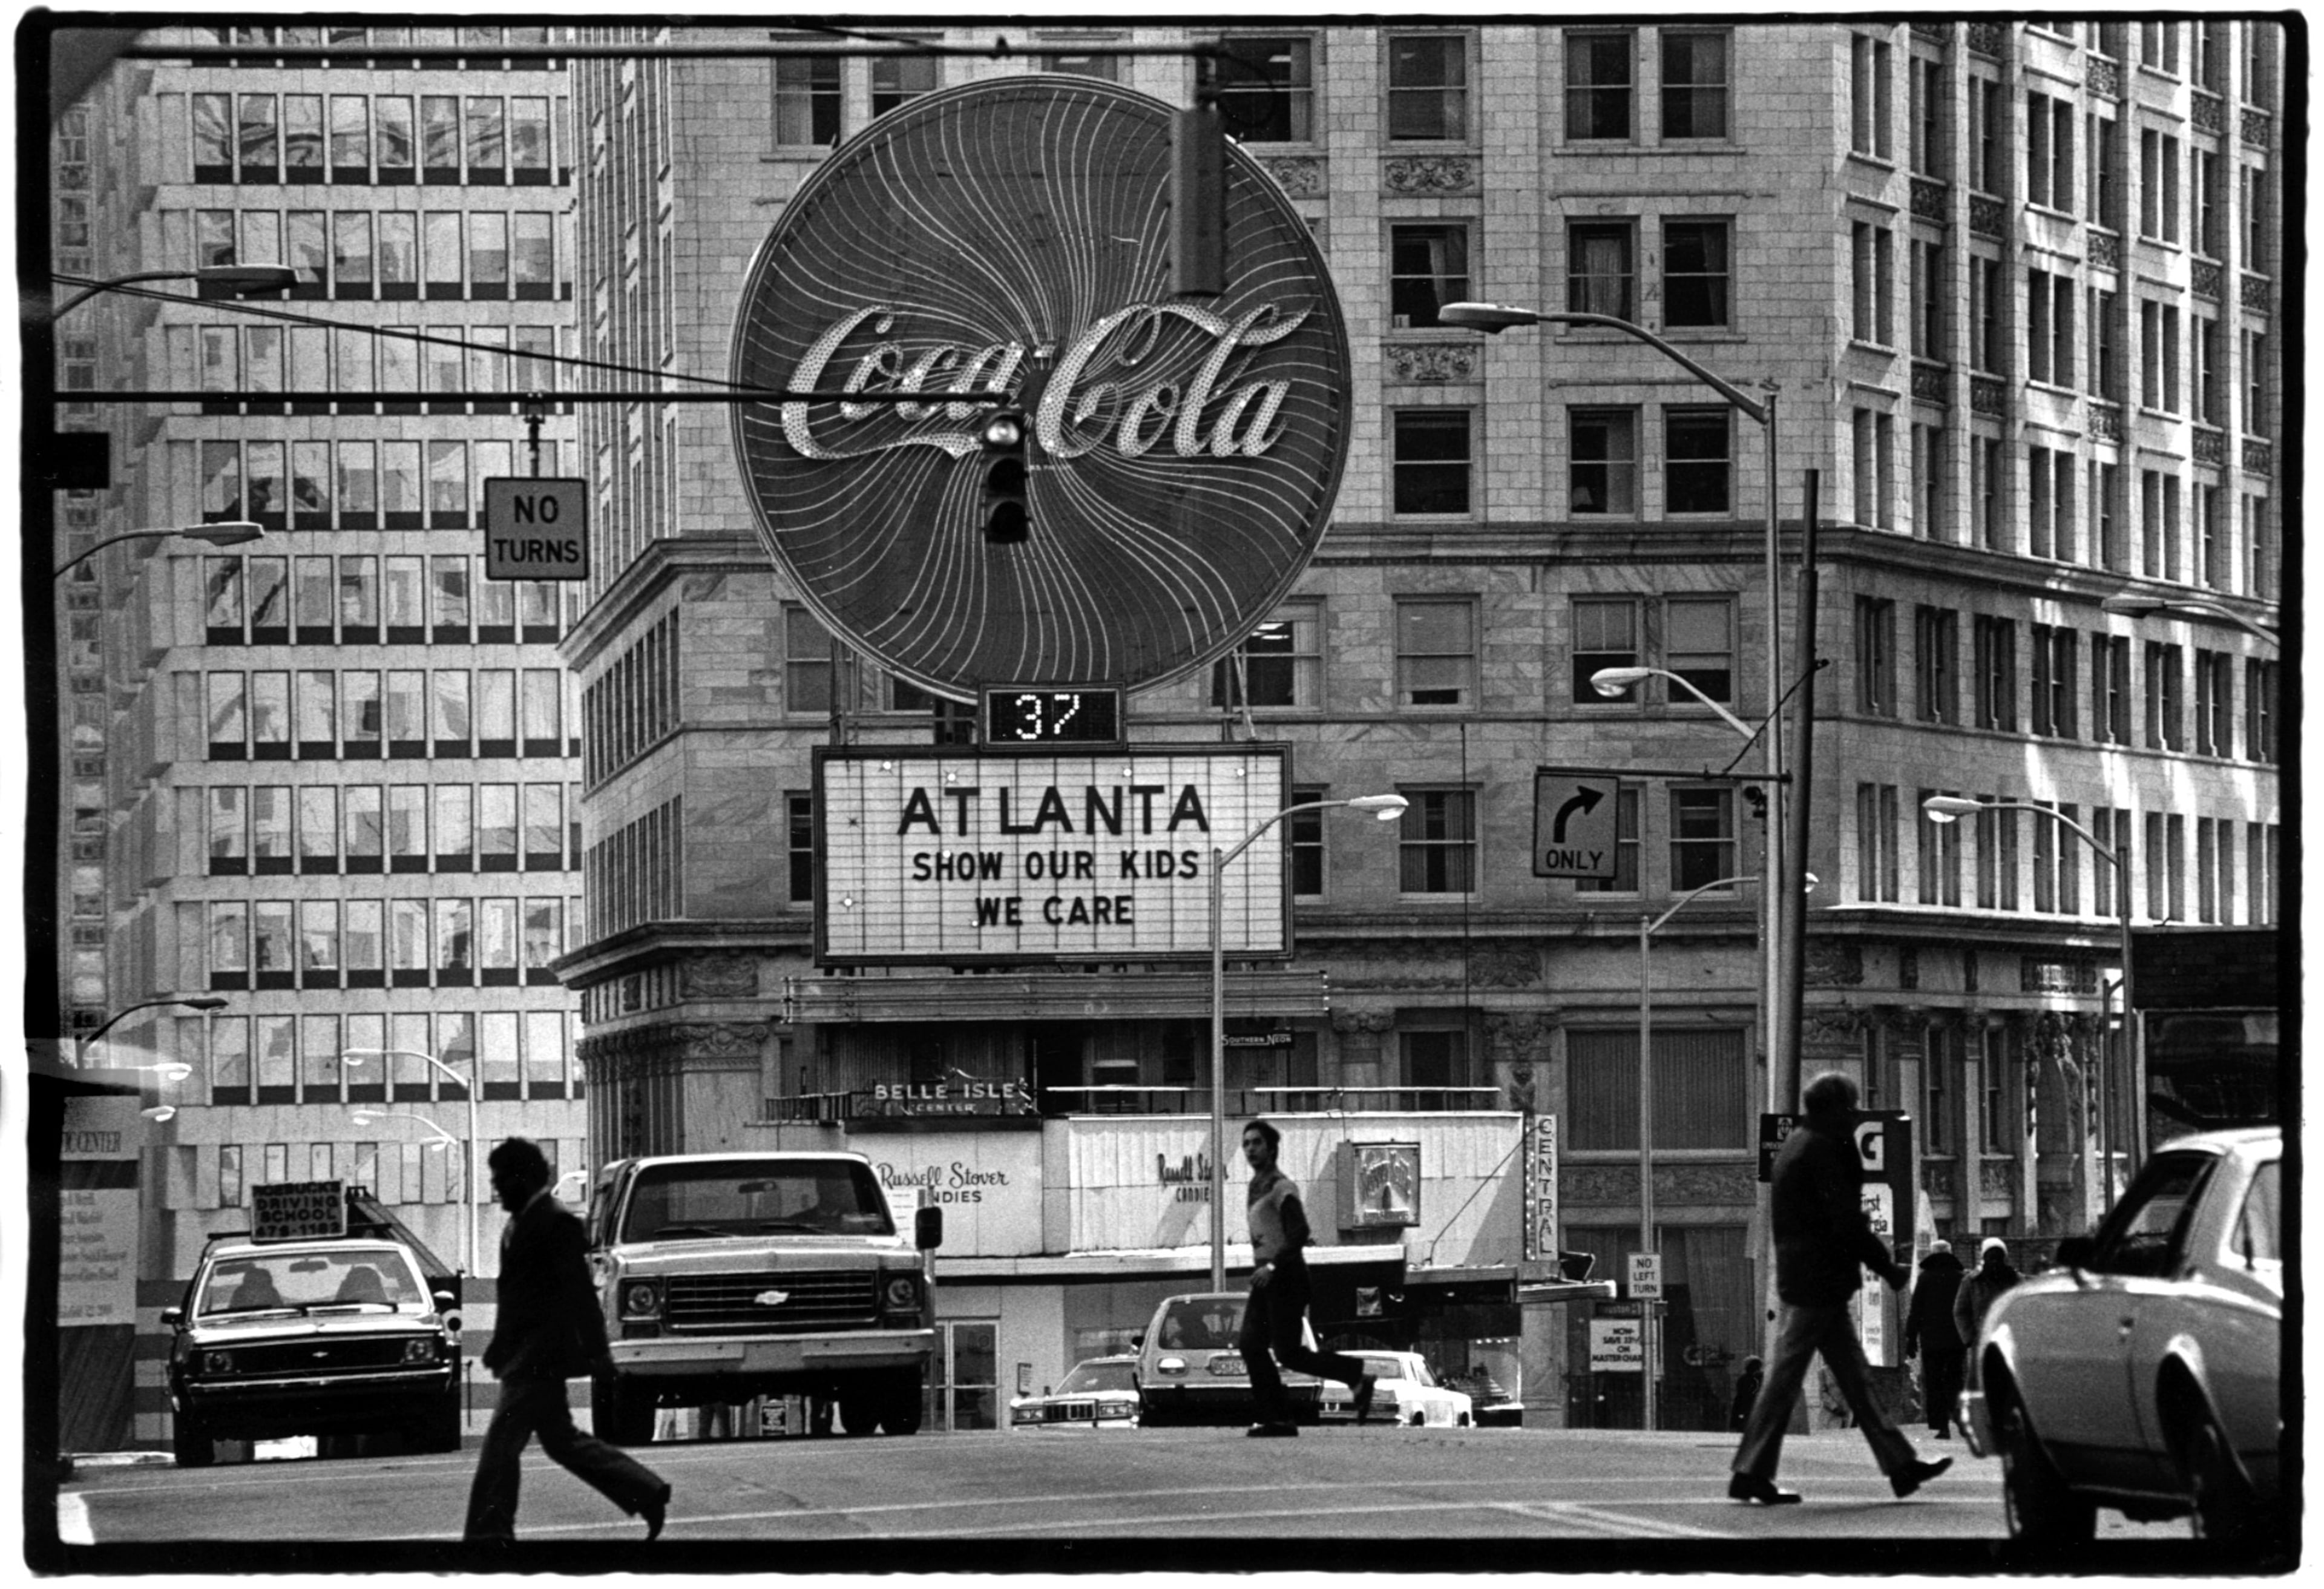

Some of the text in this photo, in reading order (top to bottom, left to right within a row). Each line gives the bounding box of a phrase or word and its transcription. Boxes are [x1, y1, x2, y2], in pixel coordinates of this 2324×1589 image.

[514, 495, 559, 524] NO
[493, 539, 580, 564] TURNS
[1015, 694, 1080, 740] 37
[896, 785, 1209, 837] ATLANTA
[911, 850, 1200, 882] SHOW OUR KIDS
[1546, 849, 1603, 870] ONLY
[975, 895, 1135, 926] WE CARE
[875, 1082, 1016, 1100] BELLE ISLE
[916, 1103, 974, 1113] CENTER
[877, 1162, 1010, 1189] Russell Stover
[1176, 1186, 1210, 1203] CANDIE
[1538, 1118, 1552, 1255] CENTRAL
[256, 1195, 339, 1210] DRIVING
[1862, 1194, 1881, 1211] irst
[260, 1209, 336, 1223] SCHOOL
[1636, 1258, 1652, 1269] NO
[1633, 1272, 1655, 1281] LEFT
[1633, 1284, 1657, 1294] TURN
[1617, 1345, 1630, 1354] ON
